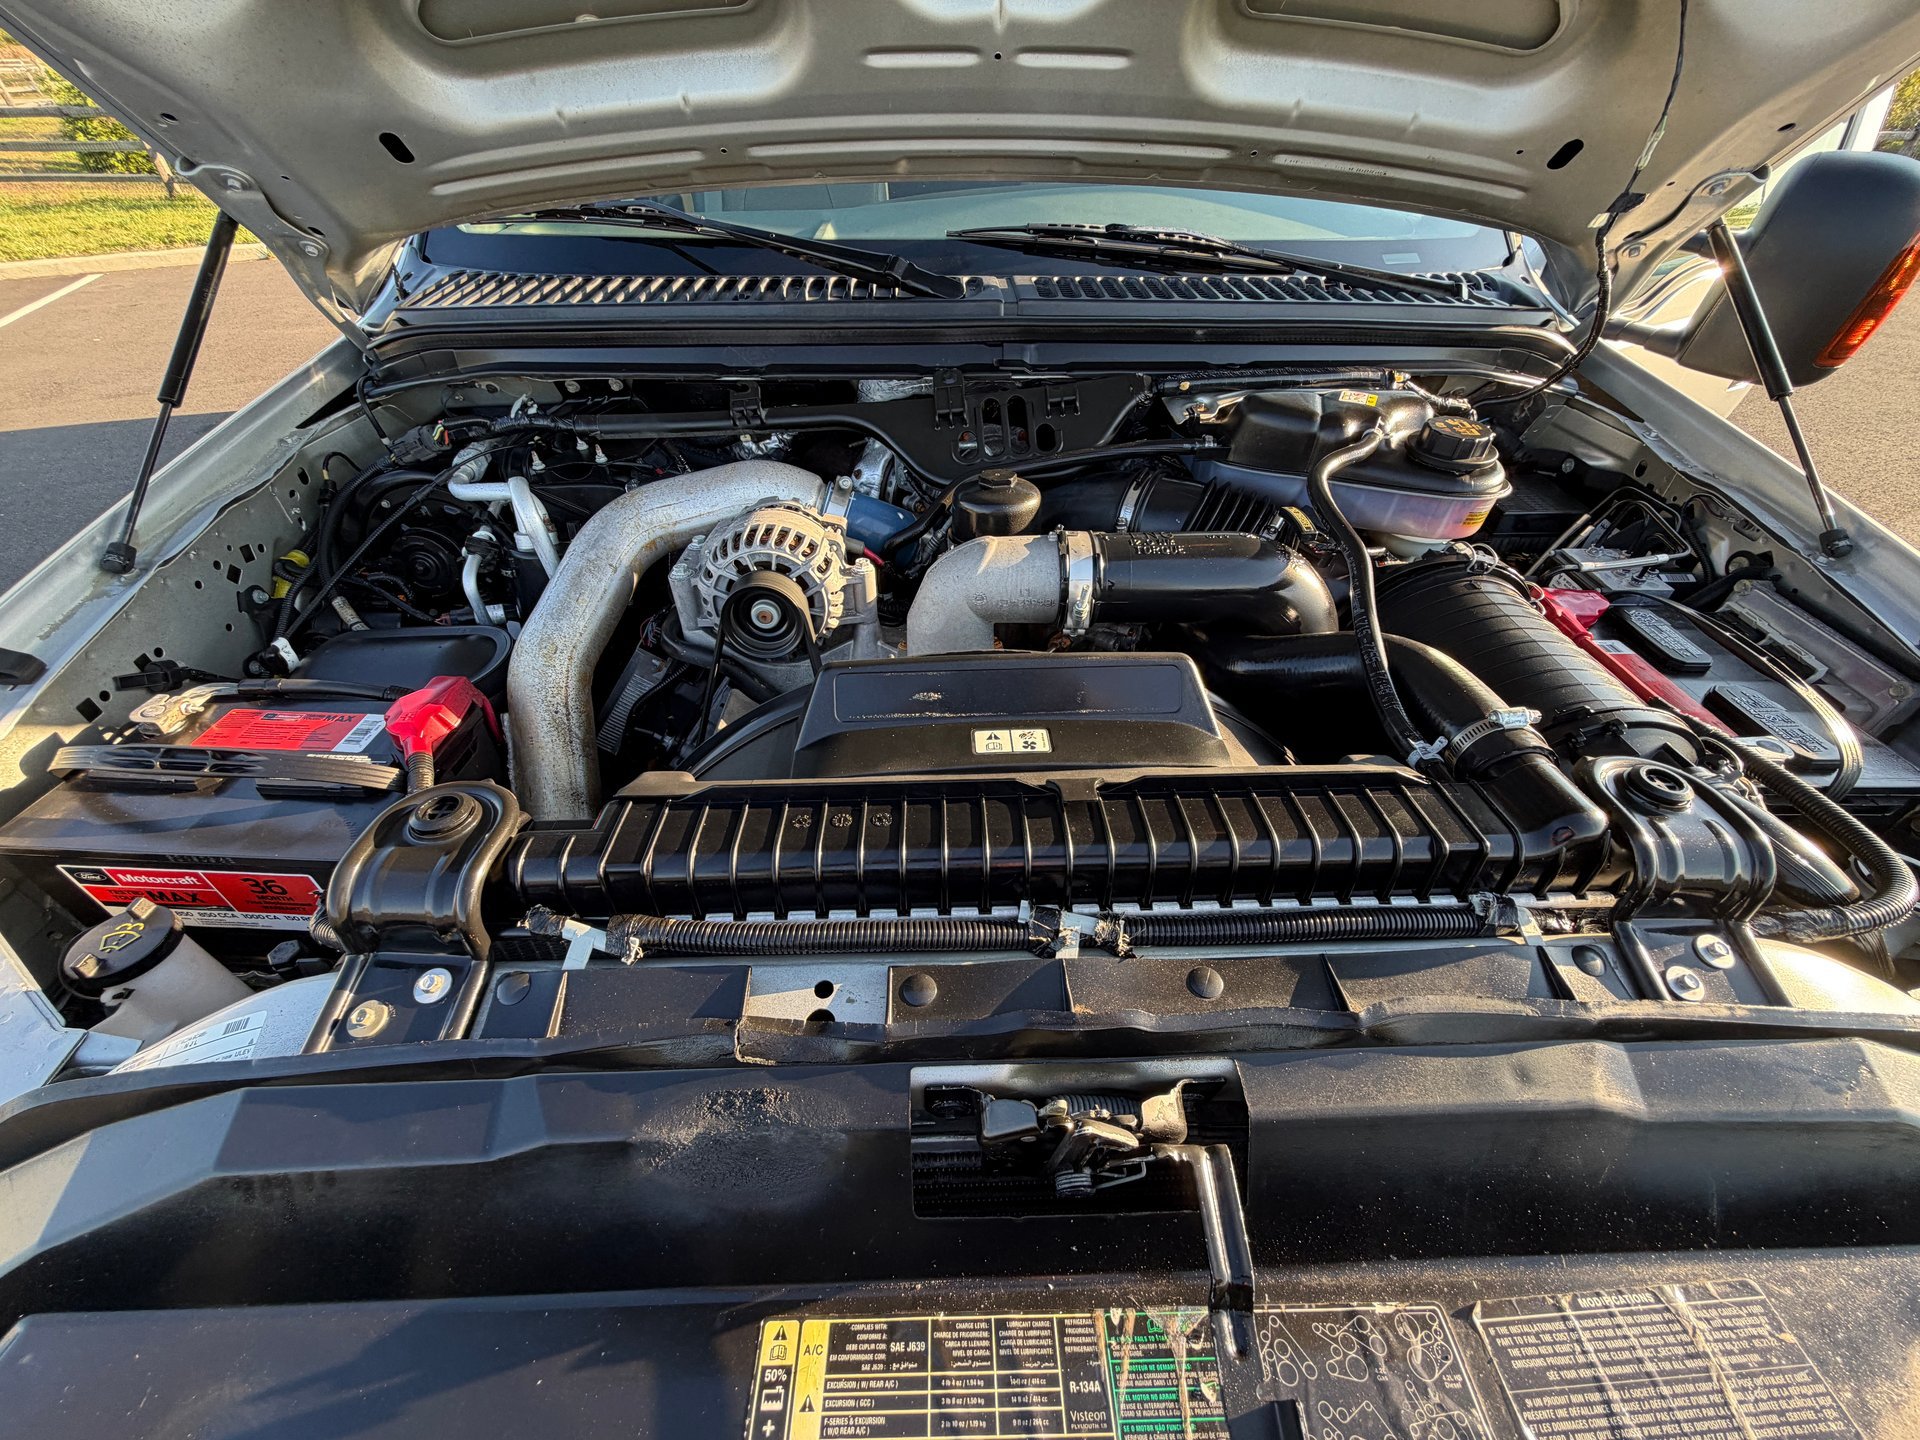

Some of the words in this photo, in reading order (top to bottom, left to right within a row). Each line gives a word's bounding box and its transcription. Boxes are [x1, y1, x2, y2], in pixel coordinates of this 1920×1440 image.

[116, 874, 201, 884] Motorcraft
[240, 878, 288, 895] 36
[145, 890, 206, 904] MAX
[1578, 1293, 1655, 1308] MODIFICATIONS
[1496, 1326, 1510, 1335] THE
[804, 1344, 824, 1356] A/C
[890, 1342, 906, 1352] SAE
[906, 1341, 926, 1352] J639
[764, 1368, 788, 1382] 50%
[827, 1381, 856, 1390] EXCURSION
[870, 1380, 884, 1388] REAR
[1070, 1380, 1101, 1394] R-134A
[825, 1400, 856, 1409] EXCURSION
[824, 1417, 848, 1426] F-SERIES
[854, 1416, 886, 1425] EXCURSION
[1070, 1410, 1107, 1422] Visteon
[840, 1426, 855, 1436] REAR
